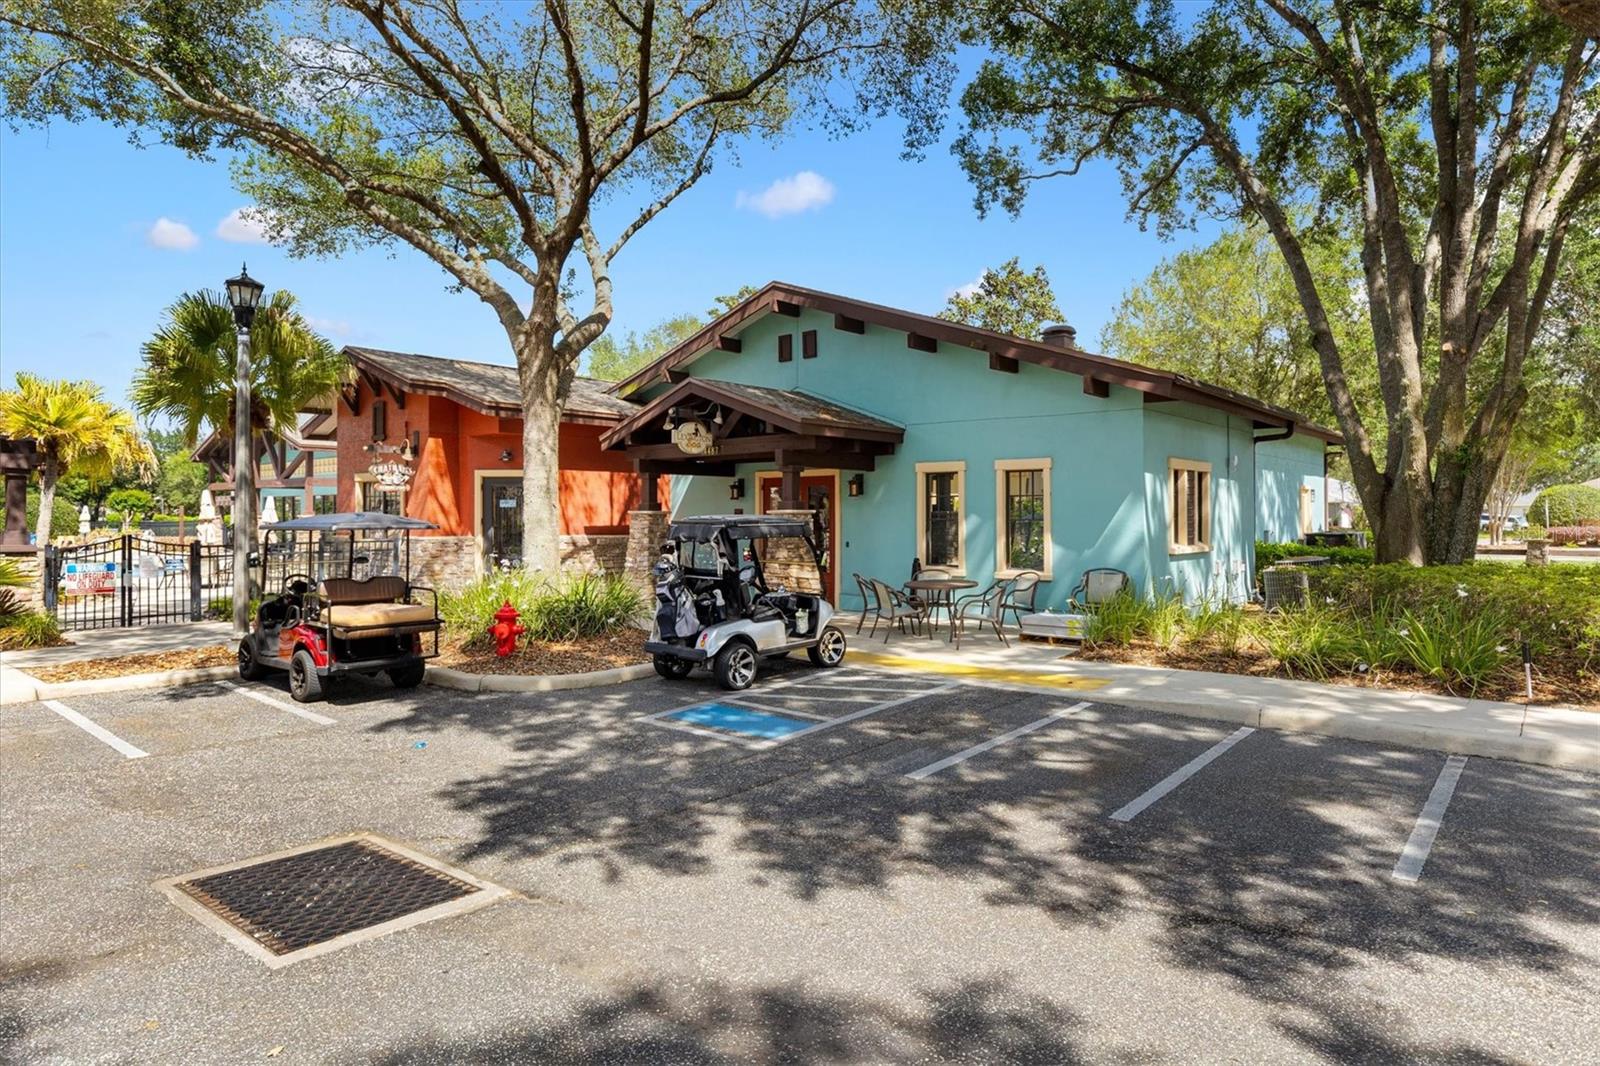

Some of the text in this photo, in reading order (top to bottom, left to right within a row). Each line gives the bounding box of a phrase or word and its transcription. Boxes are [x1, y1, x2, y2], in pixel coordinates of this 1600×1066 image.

[67, 572, 114, 582] NO LIFEGUARD
[77, 579, 105, 588] ON DUTY
